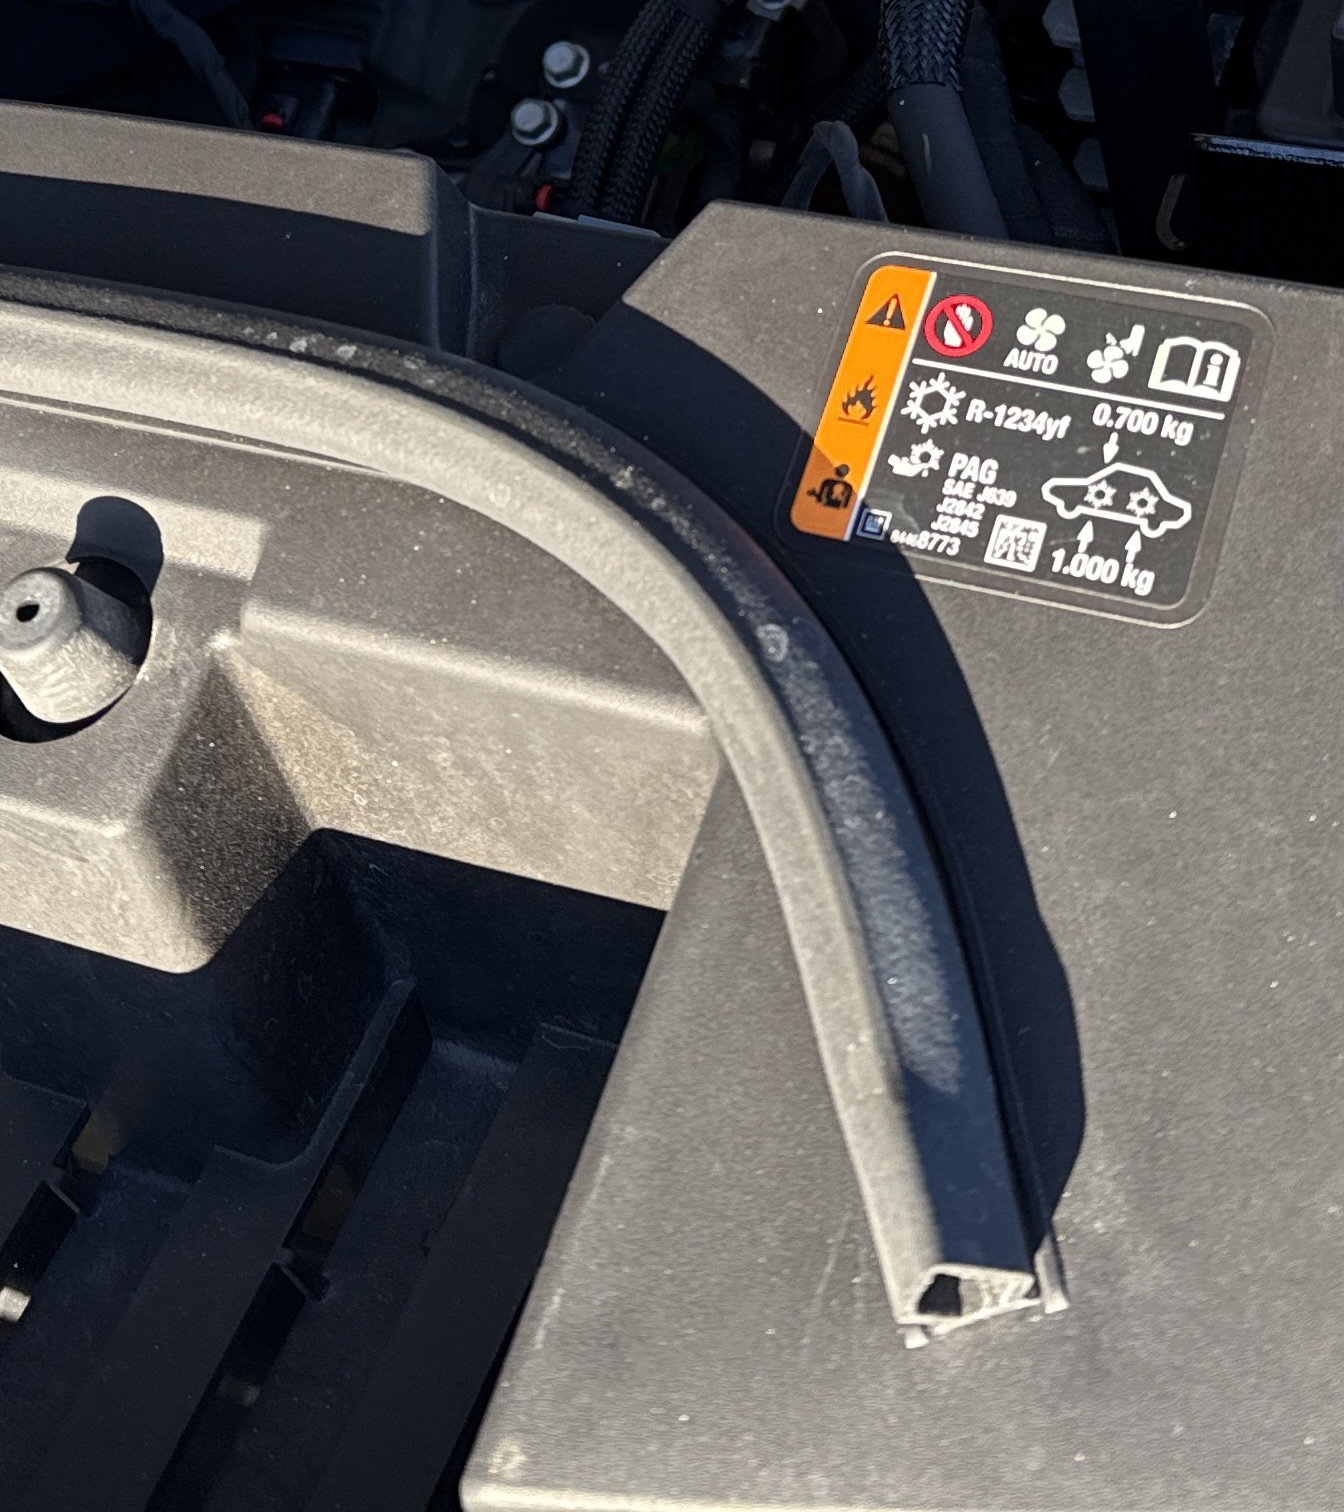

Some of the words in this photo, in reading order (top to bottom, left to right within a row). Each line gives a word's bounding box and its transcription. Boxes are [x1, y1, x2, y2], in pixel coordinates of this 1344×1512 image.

[1003, 347, 1059, 375] AUTO
[965, 398, 1072, 441] R-1234yf
[1092, 402, 1159, 435] 0.700
[1160, 414, 1194, 446] kg
[948, 452, 999, 485] PAG
[942, 478, 976, 499] SAE
[1051, 548, 1120, 584] 1.000
[1120, 562, 1155, 596] kg
